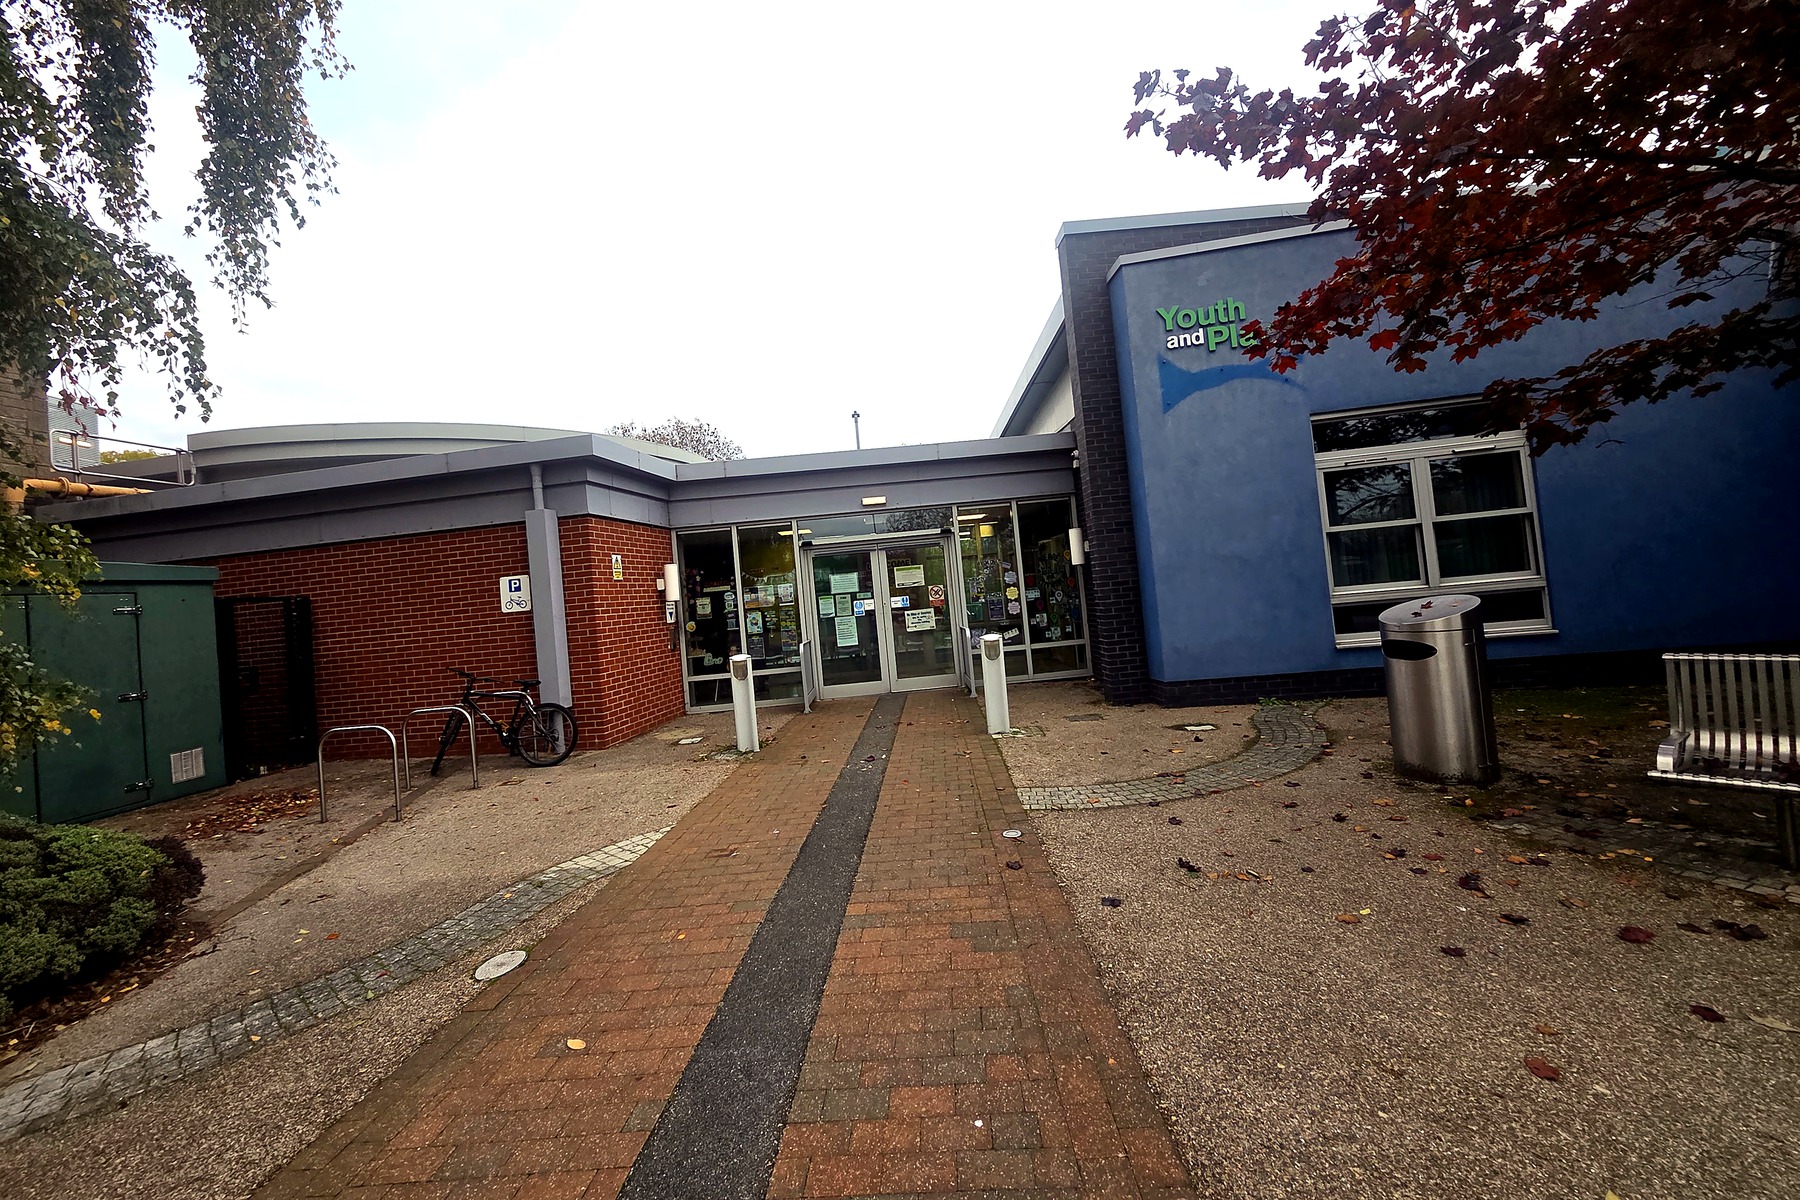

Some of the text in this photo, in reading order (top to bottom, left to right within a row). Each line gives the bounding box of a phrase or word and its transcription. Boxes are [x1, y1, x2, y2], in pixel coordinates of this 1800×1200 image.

[1156, 297, 1246, 331] Youth
[1166, 328, 1205, 349] and
[511, 580, 520, 592] P
